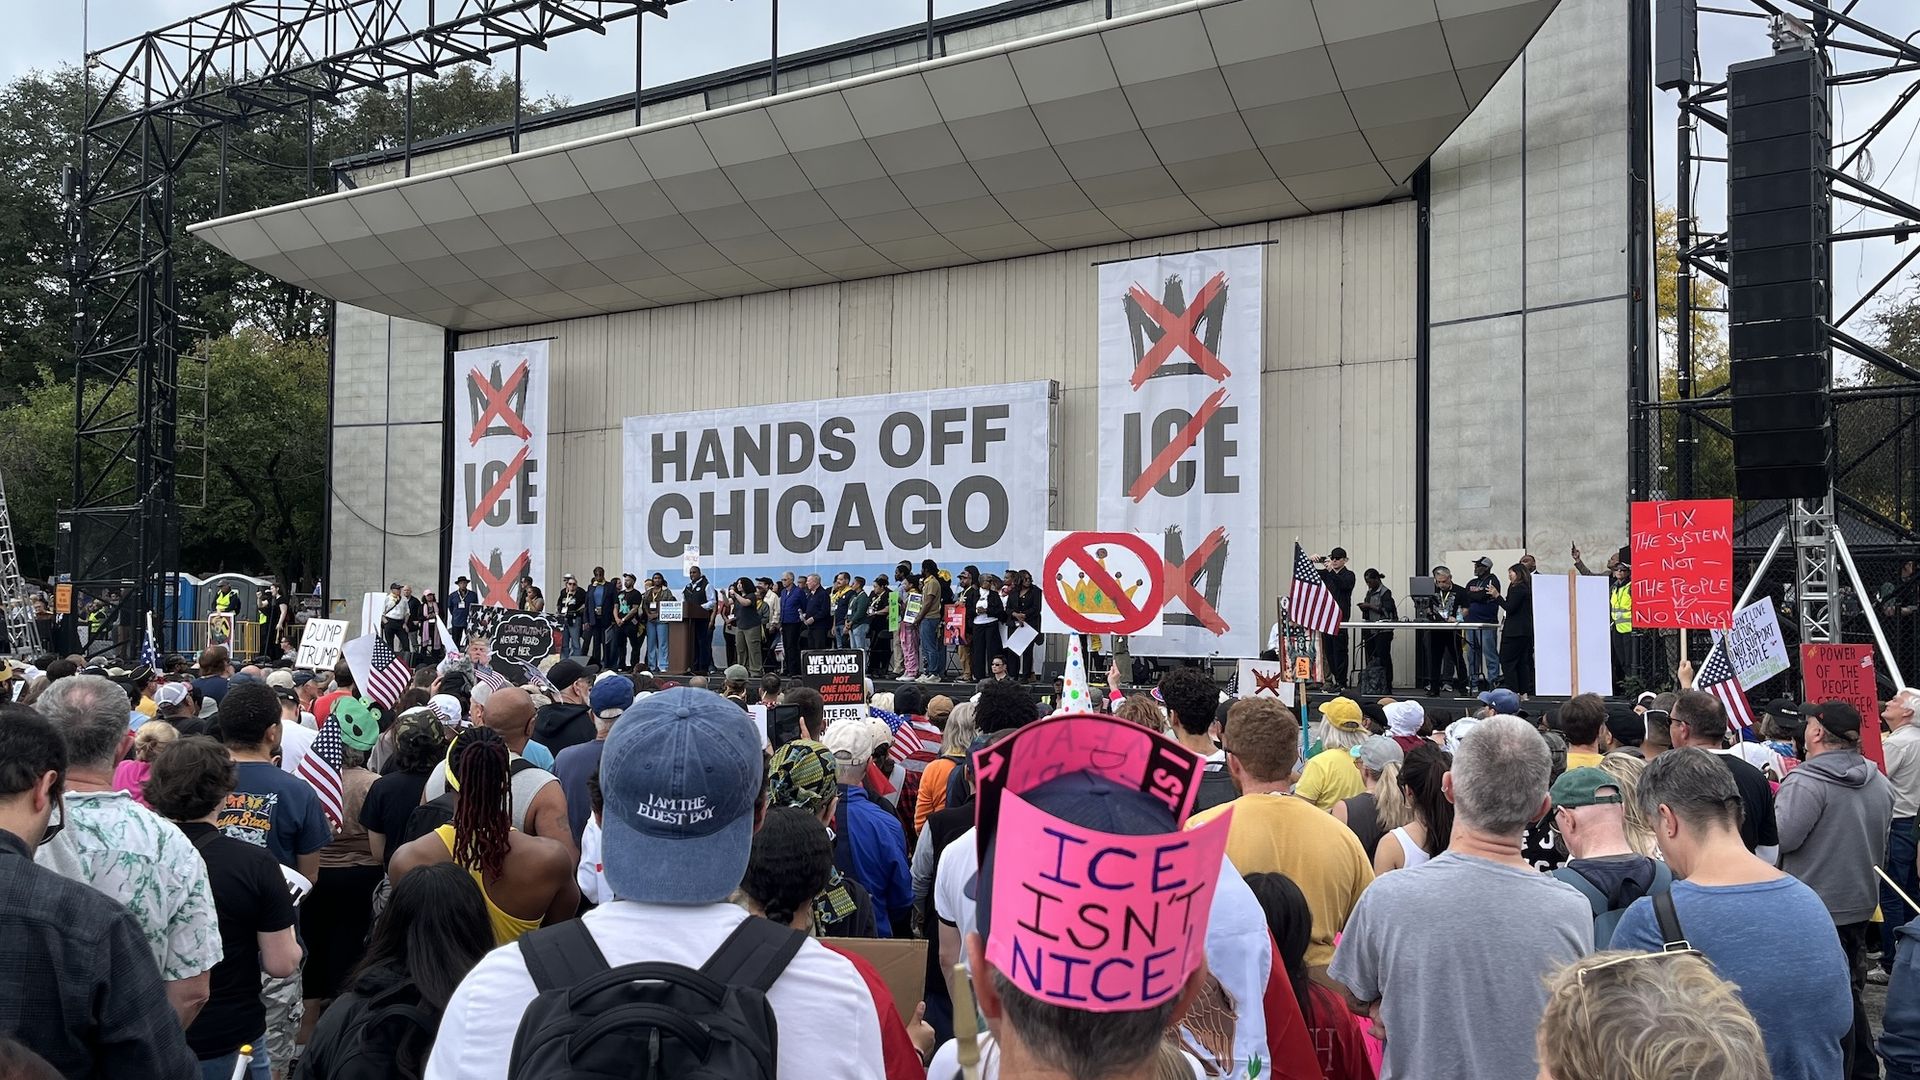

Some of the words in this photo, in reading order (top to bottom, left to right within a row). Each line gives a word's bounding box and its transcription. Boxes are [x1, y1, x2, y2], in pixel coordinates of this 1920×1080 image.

[651, 417, 856, 483] HANDS
[879, 404, 1009, 468] OFF
[1122, 406, 1240, 497] ICE
[464, 459, 538, 527] ICE
[648, 475, 1009, 558] CHICAGO
[1656, 502, 1696, 529] FIX
[1632, 532, 1660, 552] THE
[1662, 556, 1696, 571] NOT
[1635, 579, 1666, 598] THE
[1671, 577, 1729, 597] PEOPLE
[1635, 608, 1669, 622] NO
[1674, 609, 1733, 627] KINGS!
[1749, 603, 1766, 621] LOVE
[307, 622, 342, 642] DUMP
[499, 635, 519, 645] NEVER
[1731, 621, 1757, 646] CULTURE
[1733, 644, 1746, 660] NOT
[1744, 622, 1774, 651] SUPPORT
[301, 644, 339, 666] TRUMP
[505, 647, 516, 657] OF
[517, 646, 531, 656] HER
[808, 655, 824, 665] WE
[825, 654, 857, 664] WON'T
[1740, 643, 1769, 672] PEOPLE
[1820, 647, 1856, 661] POWER
[807, 665, 820, 675] BE
[821, 663, 859, 674] DIVIDED
[1816, 665, 1830, 679] OF
[1839, 665, 1859, 679] THE
[820, 685, 837, 693] ONE
[837, 684, 861, 692] MORE
[832, 676, 850, 684] NOT
[1822, 680, 1860, 695] PEOPLE
[823, 693, 863, 702] ORTATION
[840, 708, 858, 717] FOR
[648, 793, 654, 806] I
[653, 797, 677, 810] AM
[677, 795, 707, 811] THE
[636, 802, 687, 825] ELDEST
[689, 805, 716, 824] BOY
[1038, 826, 1190, 894] ICE
[1016, 882, 1206, 951] ISN'T
